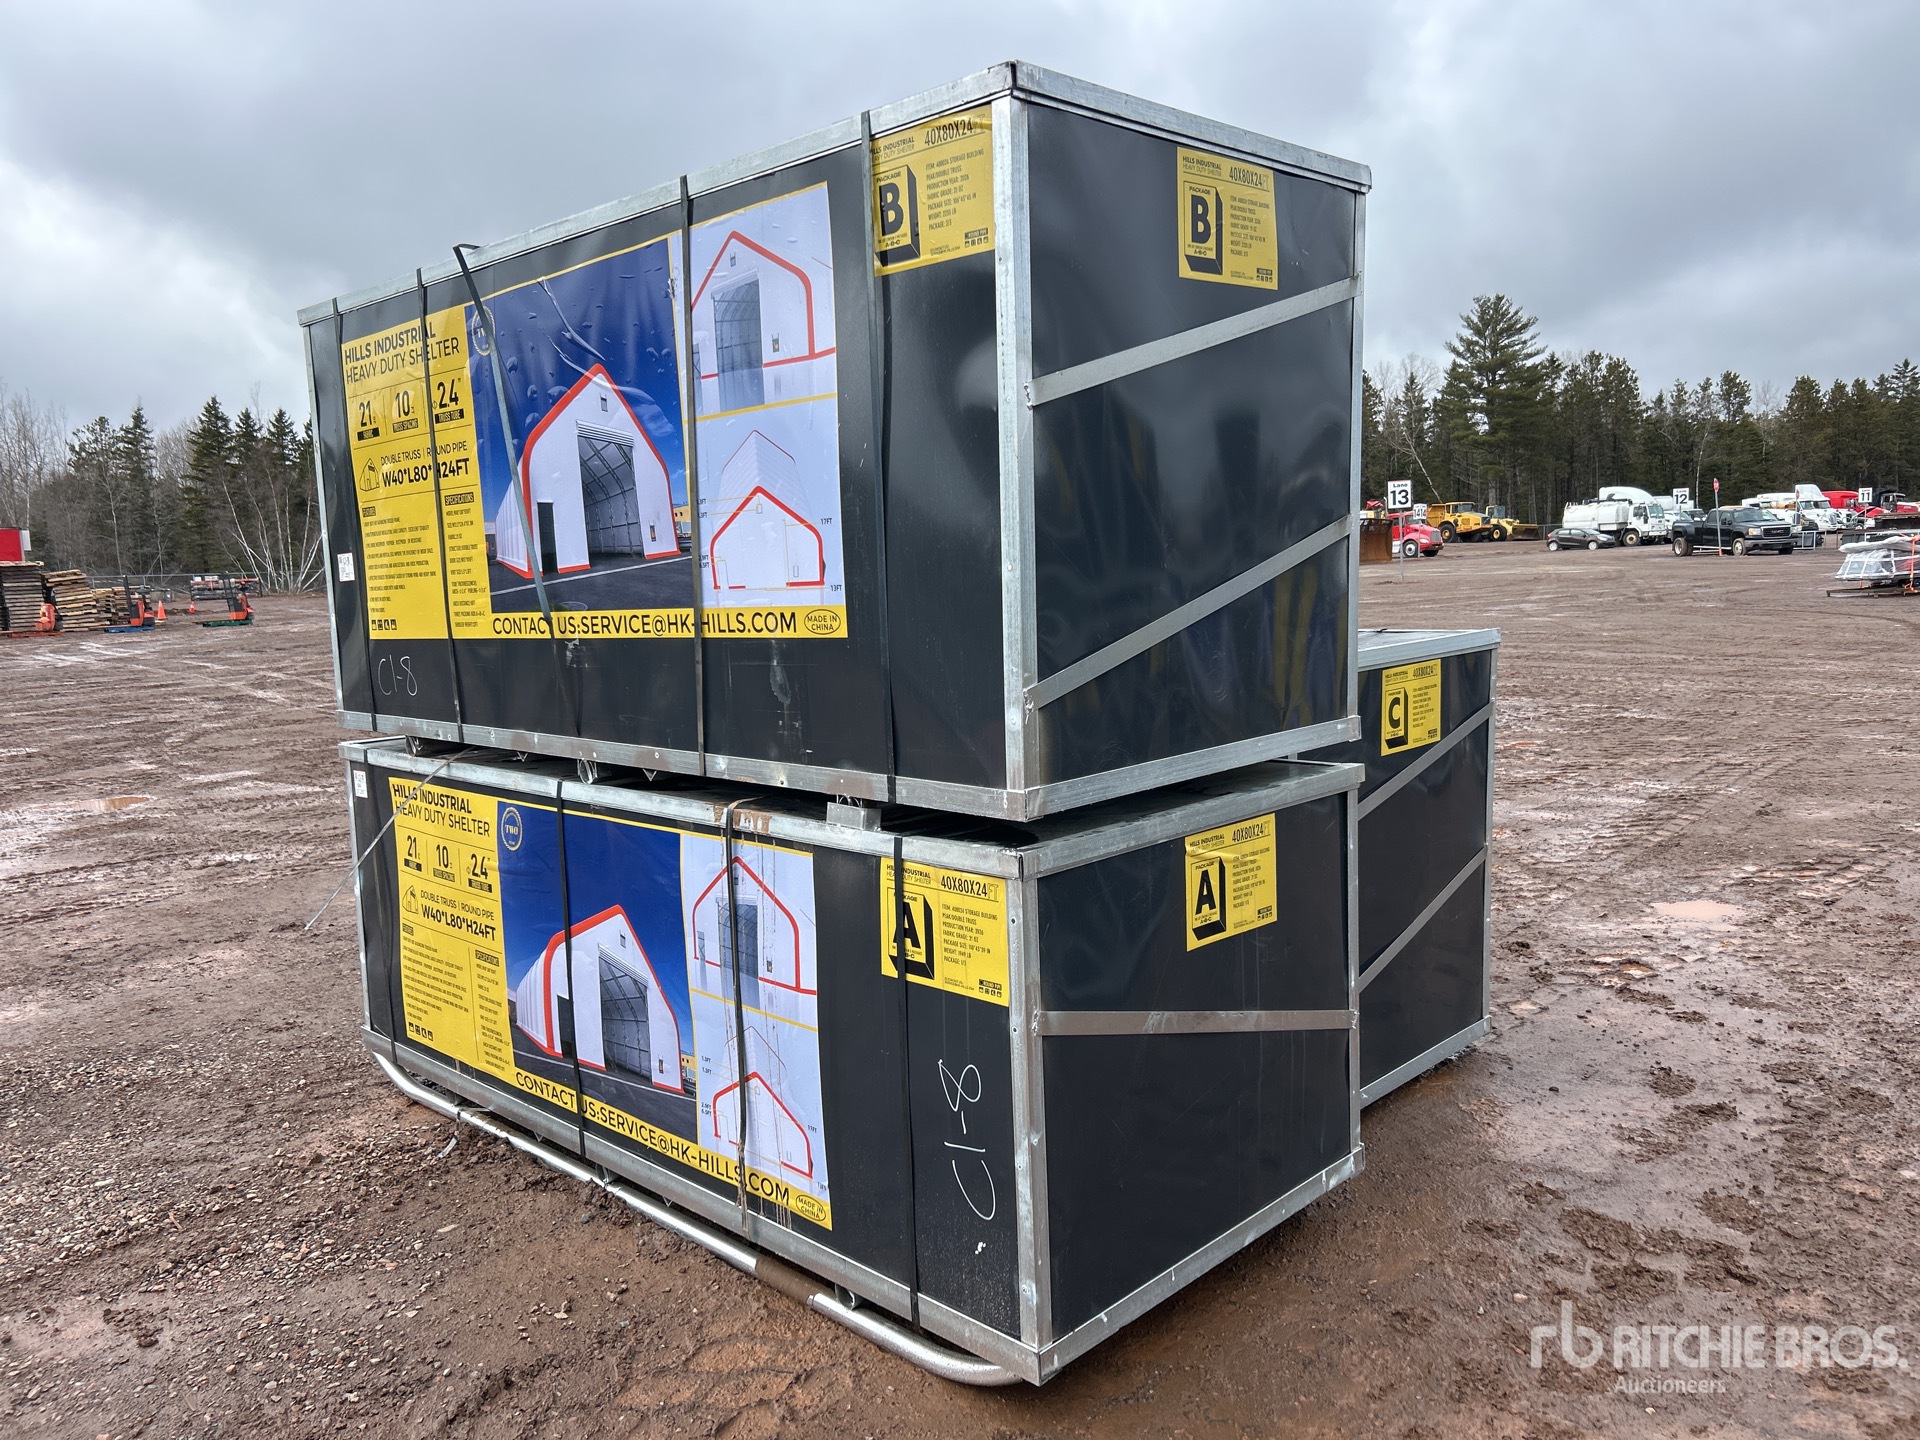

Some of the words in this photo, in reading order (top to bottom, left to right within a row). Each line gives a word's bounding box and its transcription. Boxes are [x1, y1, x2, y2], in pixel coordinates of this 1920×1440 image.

[883, 136, 915, 152] INDUSTRIAL
[1183, 156, 1195, 165] HILLS
[1196, 159, 1222, 171] INDUSTRIAL
[876, 171, 902, 183] PACKAGE
[1189, 186, 1211, 196] PACKAGE
[879, 183, 904, 237] B
[1191, 194, 1212, 244] B
[345, 343, 371, 365] HILLS
[346, 361, 378, 385] HEAVY
[380, 354, 407, 375] DUTY
[359, 401, 373, 427] 21
[396, 391, 410, 418] 10
[380, 451, 402, 466] DOUBLE
[402, 448, 422, 462] TRUSS
[452, 440, 468, 454] PIPE
[1390, 489, 1409, 506] 13
[1674, 494, 1688, 505] 12
[1861, 492, 1870, 501] 11
[493, 616, 551, 634] CONTAC
[807, 615, 828, 624] MADE
[830, 614, 838, 623] IN
[811, 623, 834, 632] CHINA
[1388, 697, 1400, 729] C
[392, 784, 418, 801] HILLS
[420, 789, 472, 814] INDUSTRIAL
[395, 801, 422, 820] HEAVY
[424, 808, 446, 826] DUTY
[449, 814, 490, 837] SHELTER
[407, 835, 417, 858] 21
[1190, 839, 1200, 847] HILLS
[1201, 833, 1225, 845] INDUSTRIAL
[436, 844, 449, 869] 10
[1195, 861, 1215, 870] PACKAGE
[903, 868, 931, 879] NDUSTRIAL
[914, 876, 932, 885] SHELTER
[941, 875, 999, 900] 40X80X24FT
[1195, 869, 1217, 915] A
[420, 889, 440, 904] DOUBLE
[440, 895, 457, 909] TRUSS
[461, 902, 481, 917] ROUND
[481, 908, 495, 921] PIPE
[893, 902, 921, 949] A
[516, 1072, 575, 1109] CONTACT
[798, 1197, 816, 1209] MADE
[801, 1207, 820, 1219] CHINA
